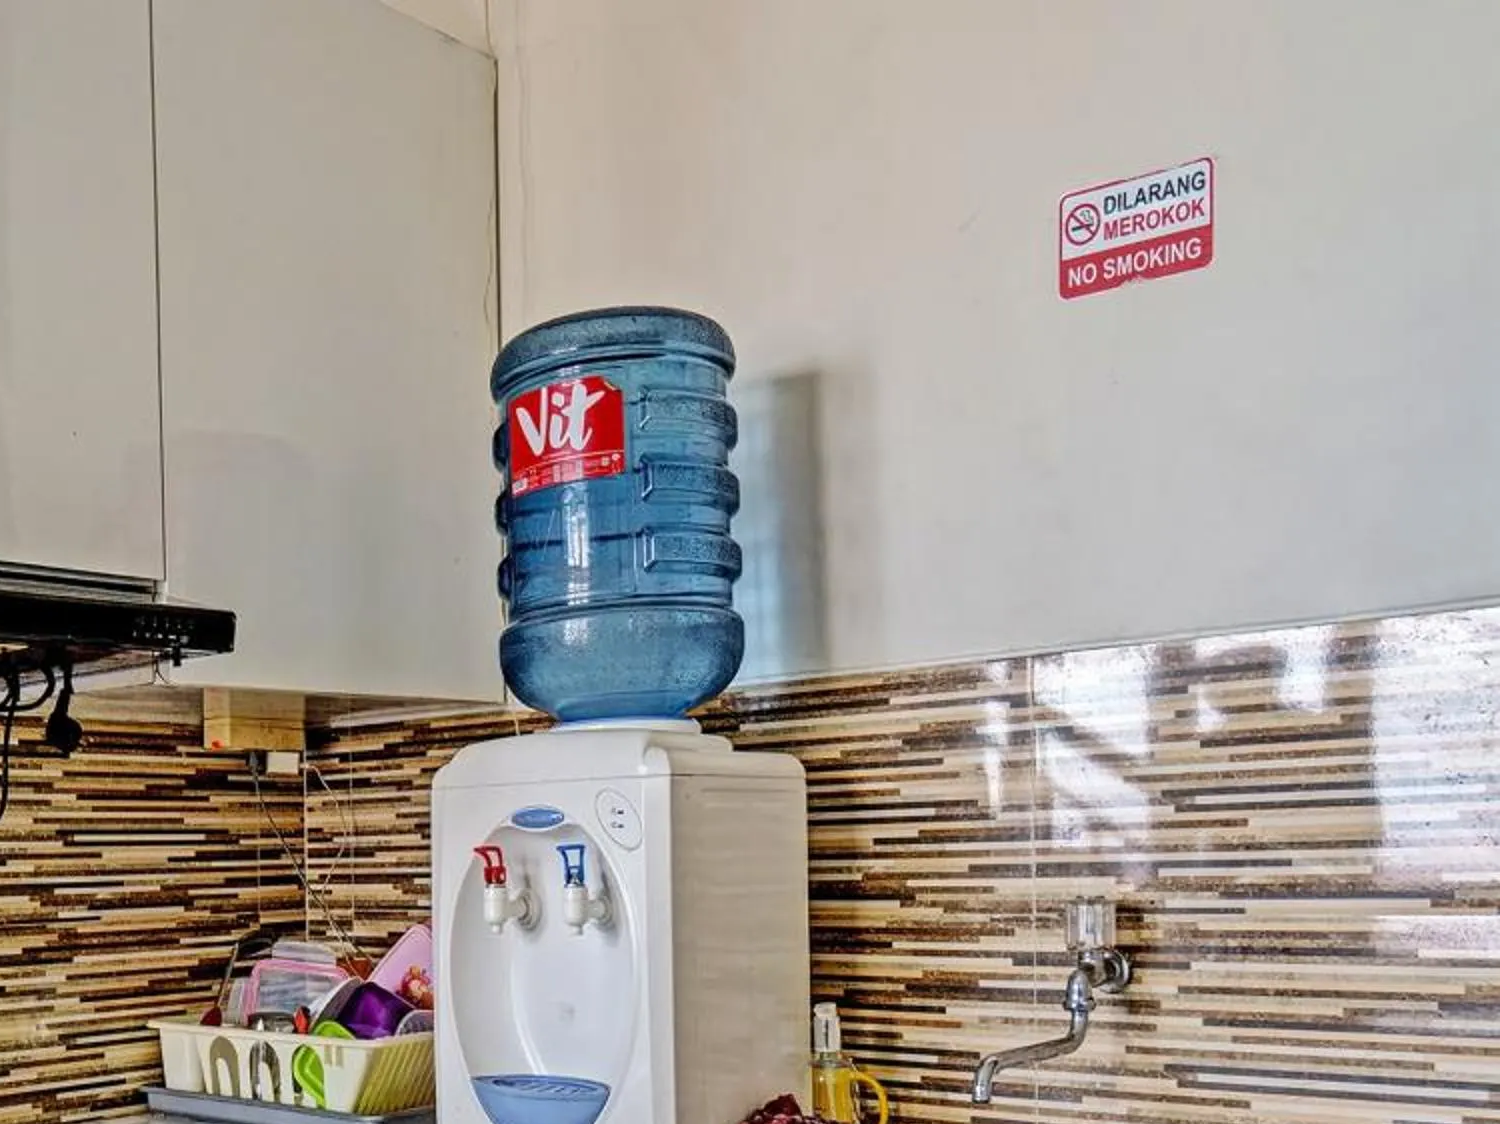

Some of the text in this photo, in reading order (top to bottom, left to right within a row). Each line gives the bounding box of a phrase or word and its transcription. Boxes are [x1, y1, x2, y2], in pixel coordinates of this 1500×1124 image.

[1103, 171, 1206, 215] DILARANG
[1103, 197, 1205, 241] MEROKOK
[1068, 237, 1202, 288] NO SMOKING
[516, 383, 605, 456] Vit
